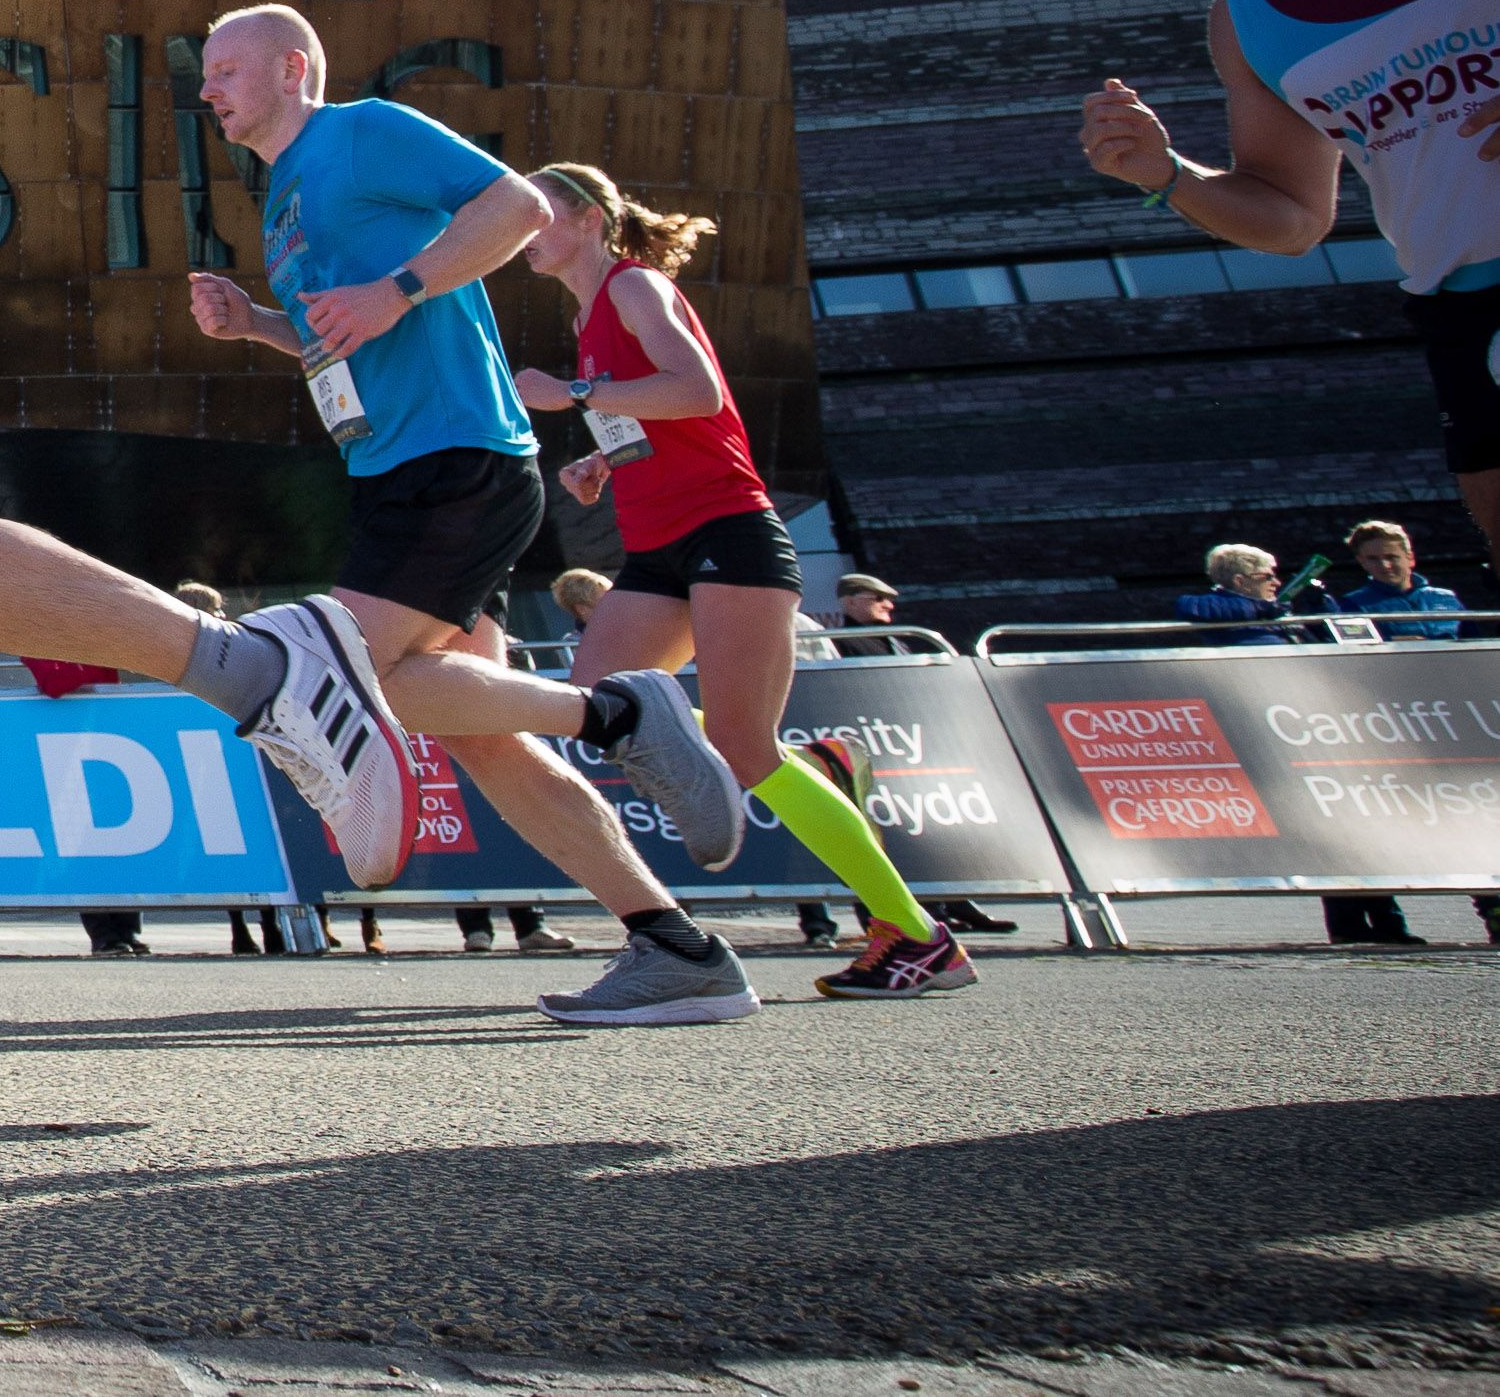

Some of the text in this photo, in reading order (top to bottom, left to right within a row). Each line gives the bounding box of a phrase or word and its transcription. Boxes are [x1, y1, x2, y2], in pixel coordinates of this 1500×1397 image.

[1322, 22, 1500, 111] BRAIN TUMOU
[1436, 107, 1460, 124] are
[1061, 704, 1205, 740] CARDIFF
[1266, 700, 1460, 747] Cardiff
[780, 715, 923, 765] ersity
[1080, 740, 1217, 761] UNIVERSITY
[1100, 775, 1240, 796] PRIFYSGOL
[1107, 796, 1257, 831] CAERDYDD
